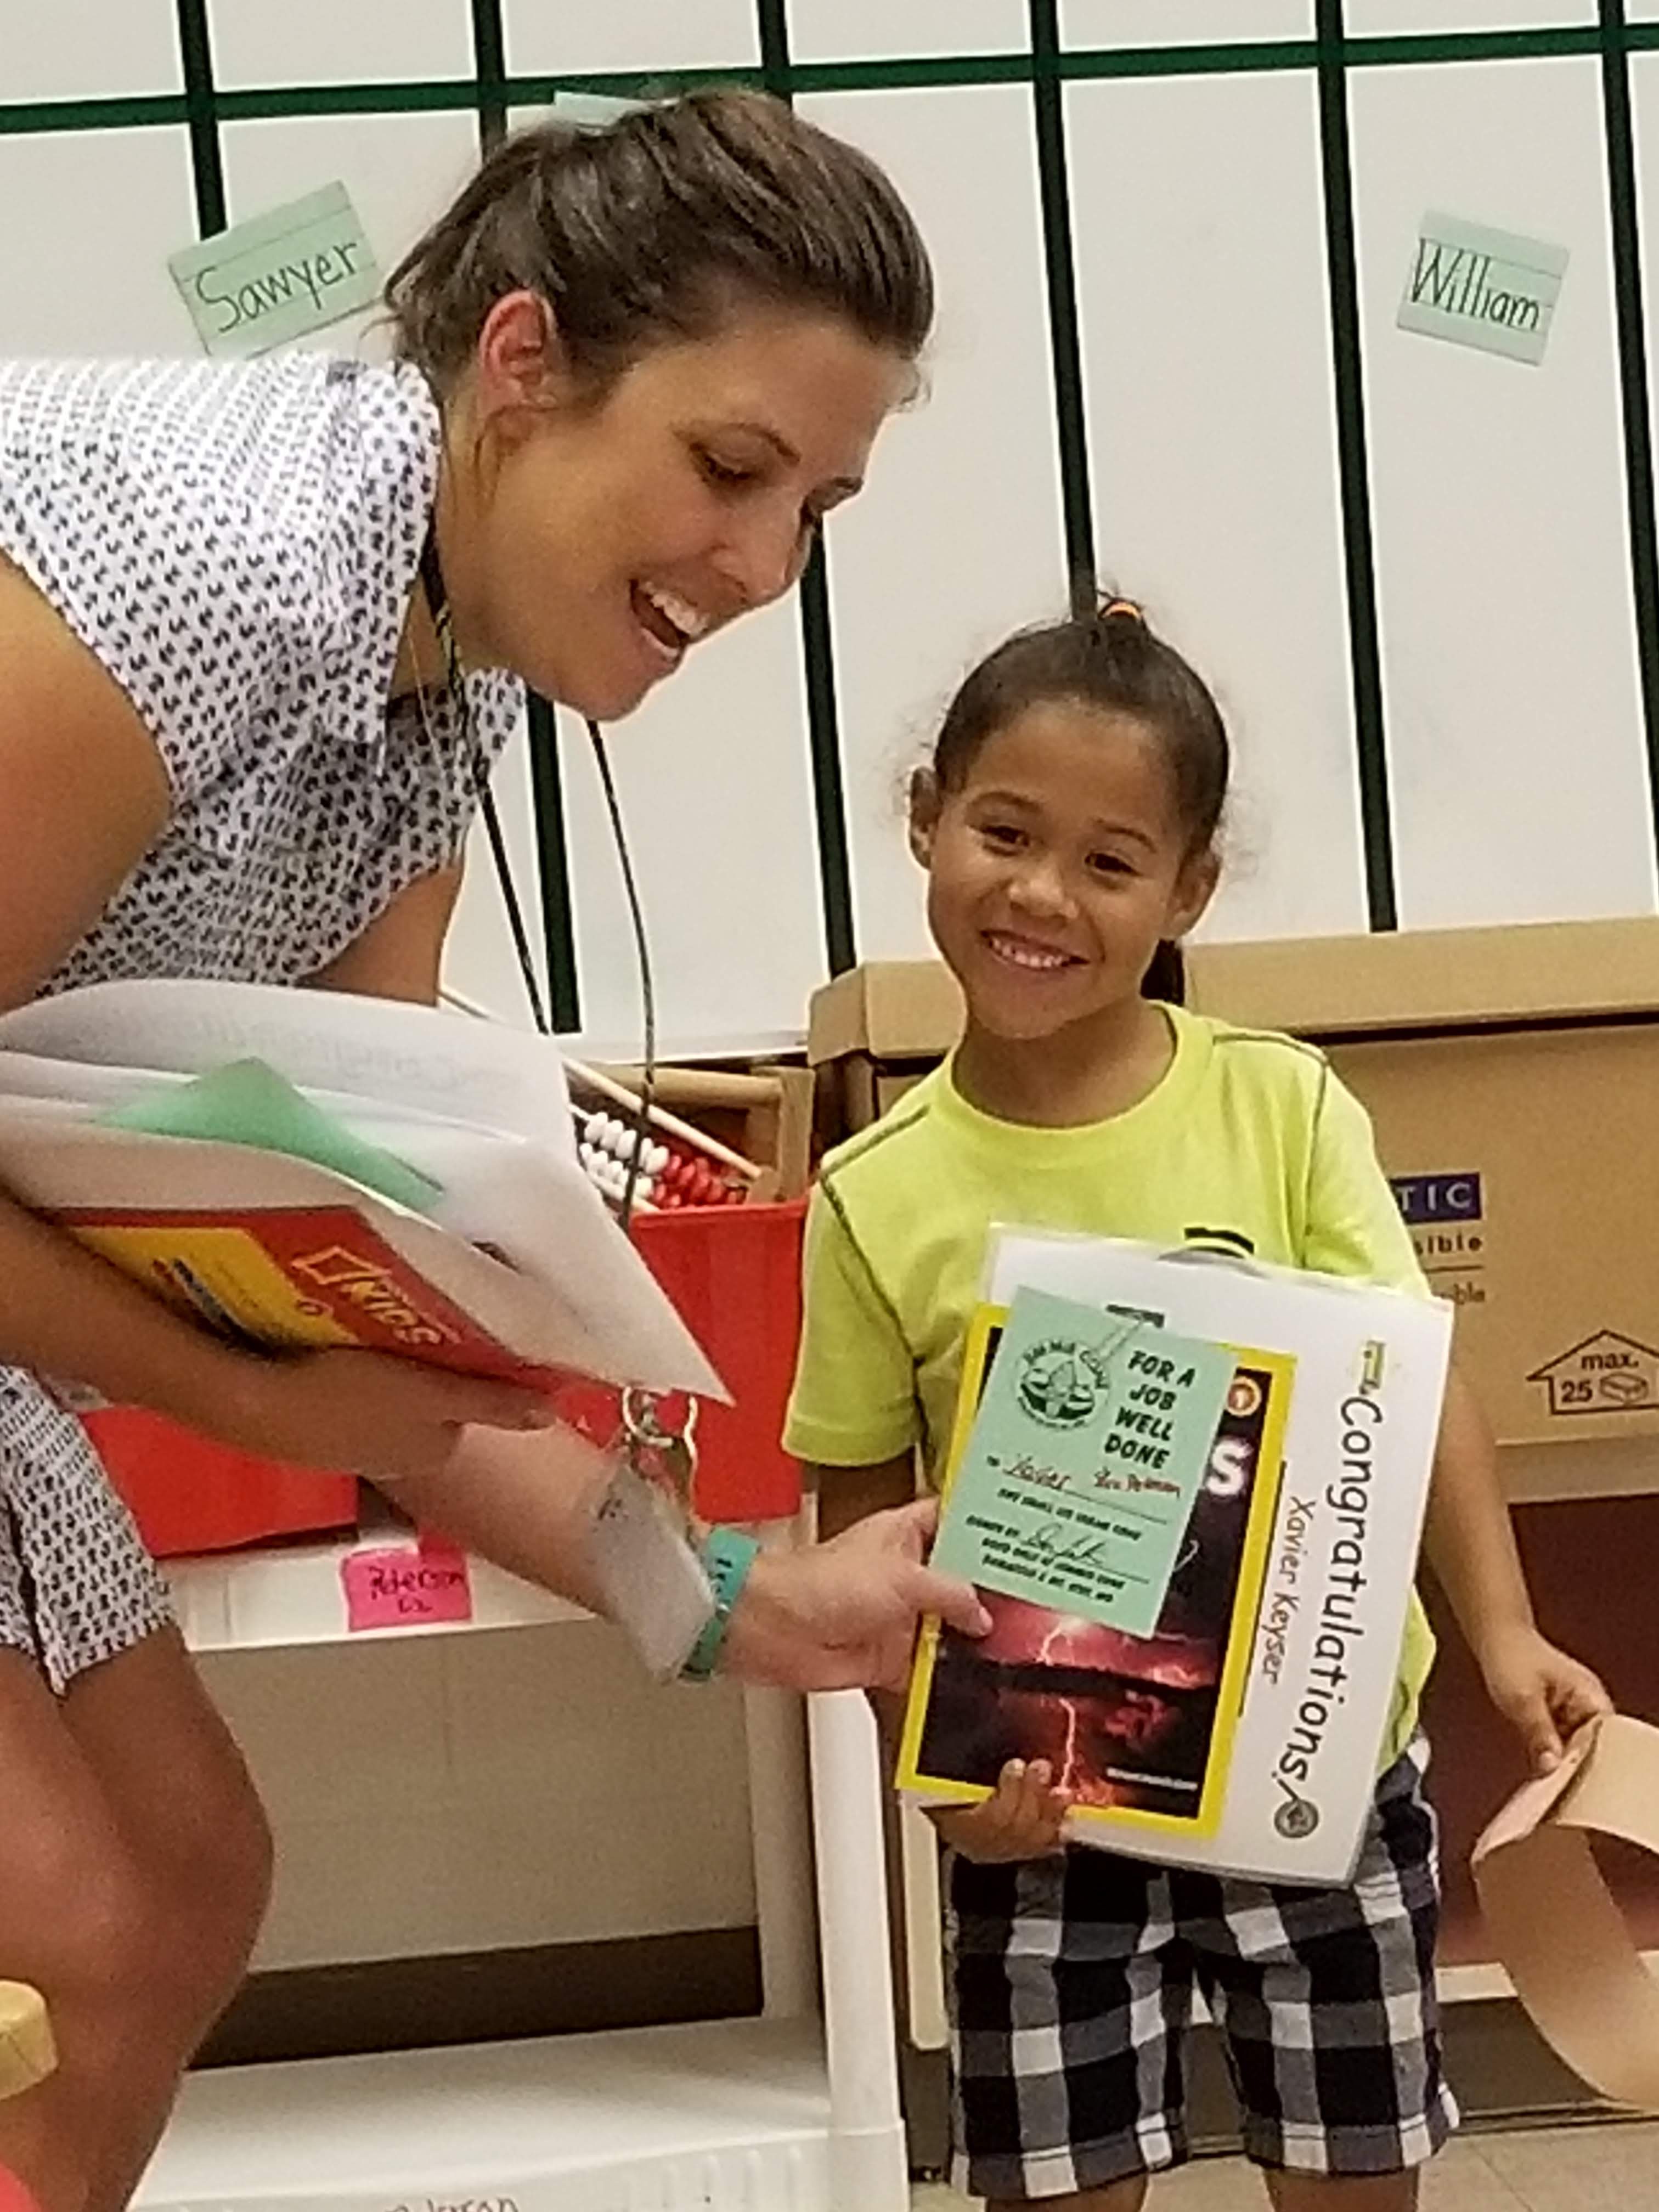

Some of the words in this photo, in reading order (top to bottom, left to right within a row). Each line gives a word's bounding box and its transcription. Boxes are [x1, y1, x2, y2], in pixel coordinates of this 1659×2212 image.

[196, 242, 357, 332] Sawyer
[1412, 237, 1539, 331] William
[1396, 1182, 1472, 1211] TIC
[1128, 1350, 1175, 1384] FOR
[1177, 1368, 1196, 1388] A
[1581, 1352, 1639, 1370] max.
[1130, 1384, 1177, 1411] JOB
[1561, 1379, 1593, 1402] 25
[1115, 1406, 1173, 1442] WELL
[1104, 1432, 1170, 1470] DONE
[1279, 1496, 1317, 1585] Xavier
[1261, 1592, 1300, 1685] Keyser
